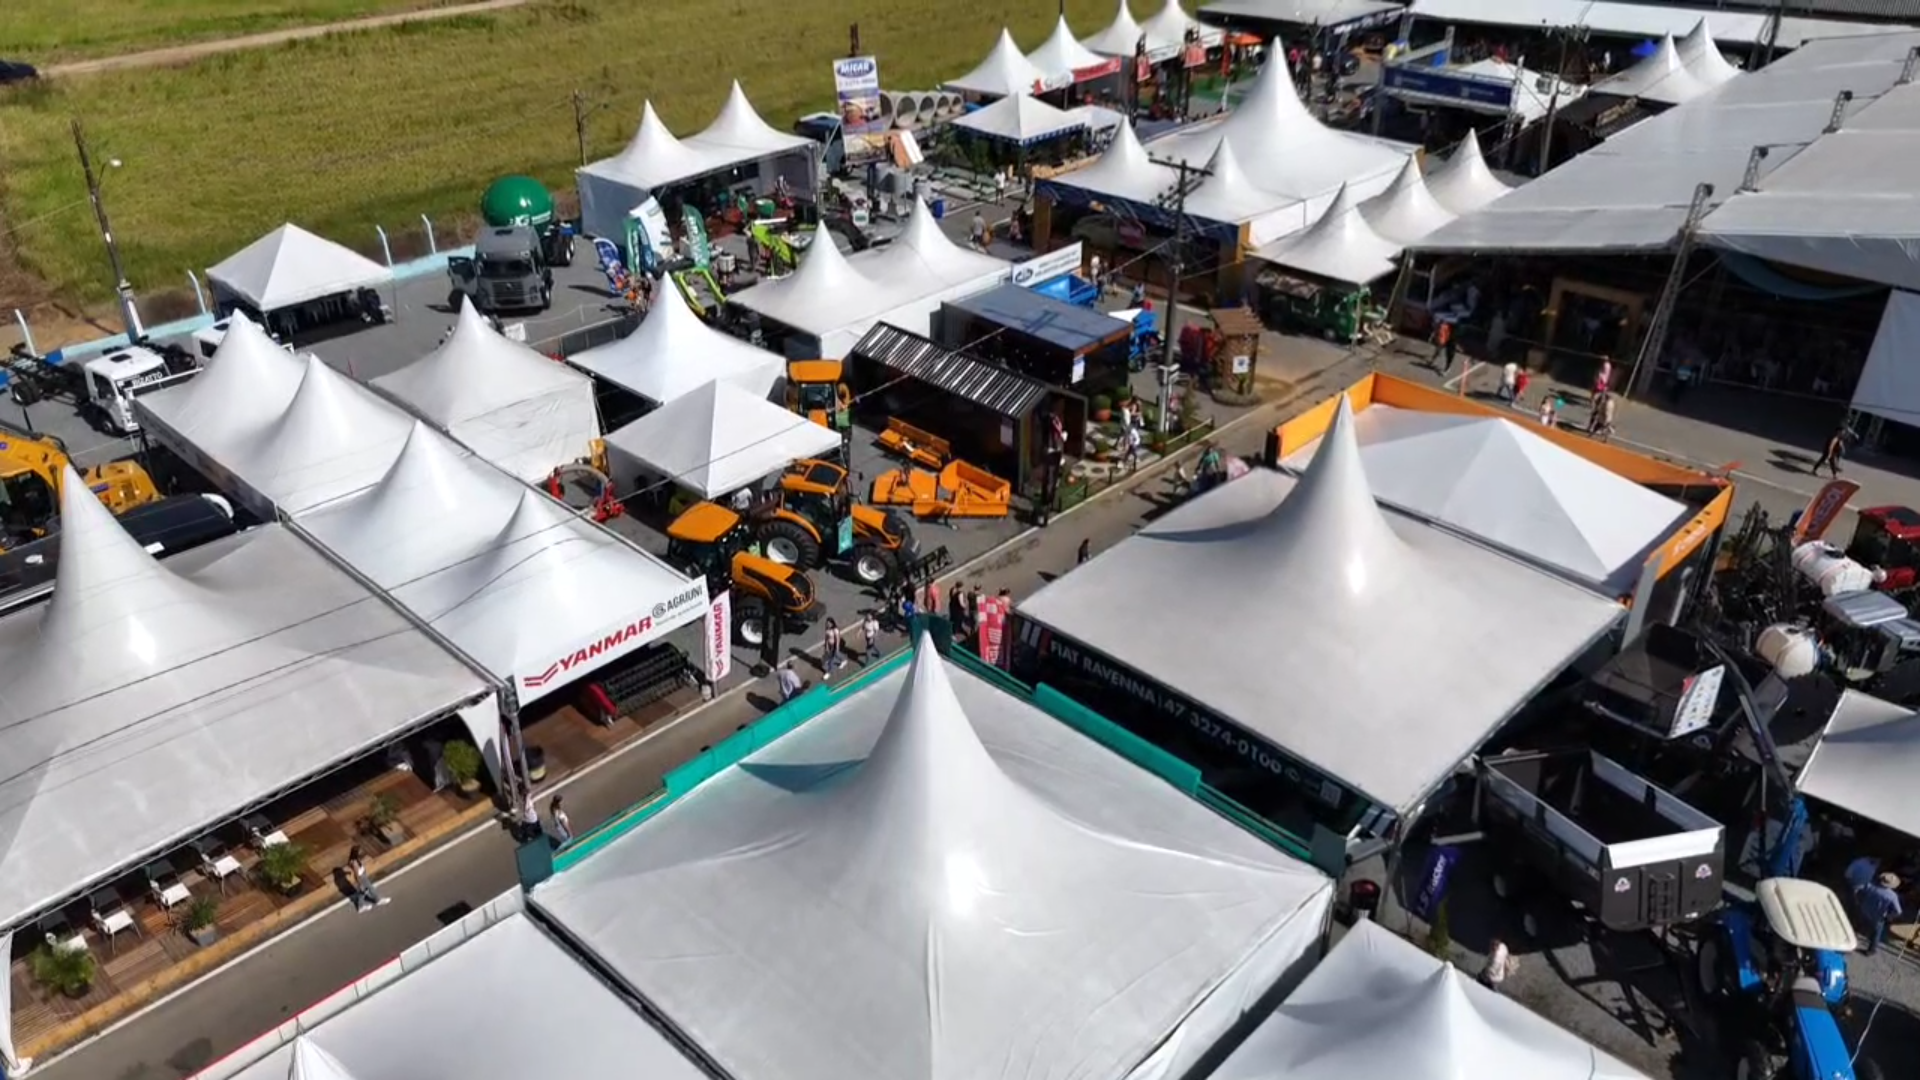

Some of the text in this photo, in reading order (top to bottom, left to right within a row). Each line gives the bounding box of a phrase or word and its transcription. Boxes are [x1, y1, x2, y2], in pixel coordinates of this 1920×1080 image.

[559, 616, 652, 671] YANMAR
[713, 602, 723, 657] YANMAR
[1050, 640, 1080, 665] FIAT
[1083, 656, 1156, 702] RAVENNA
